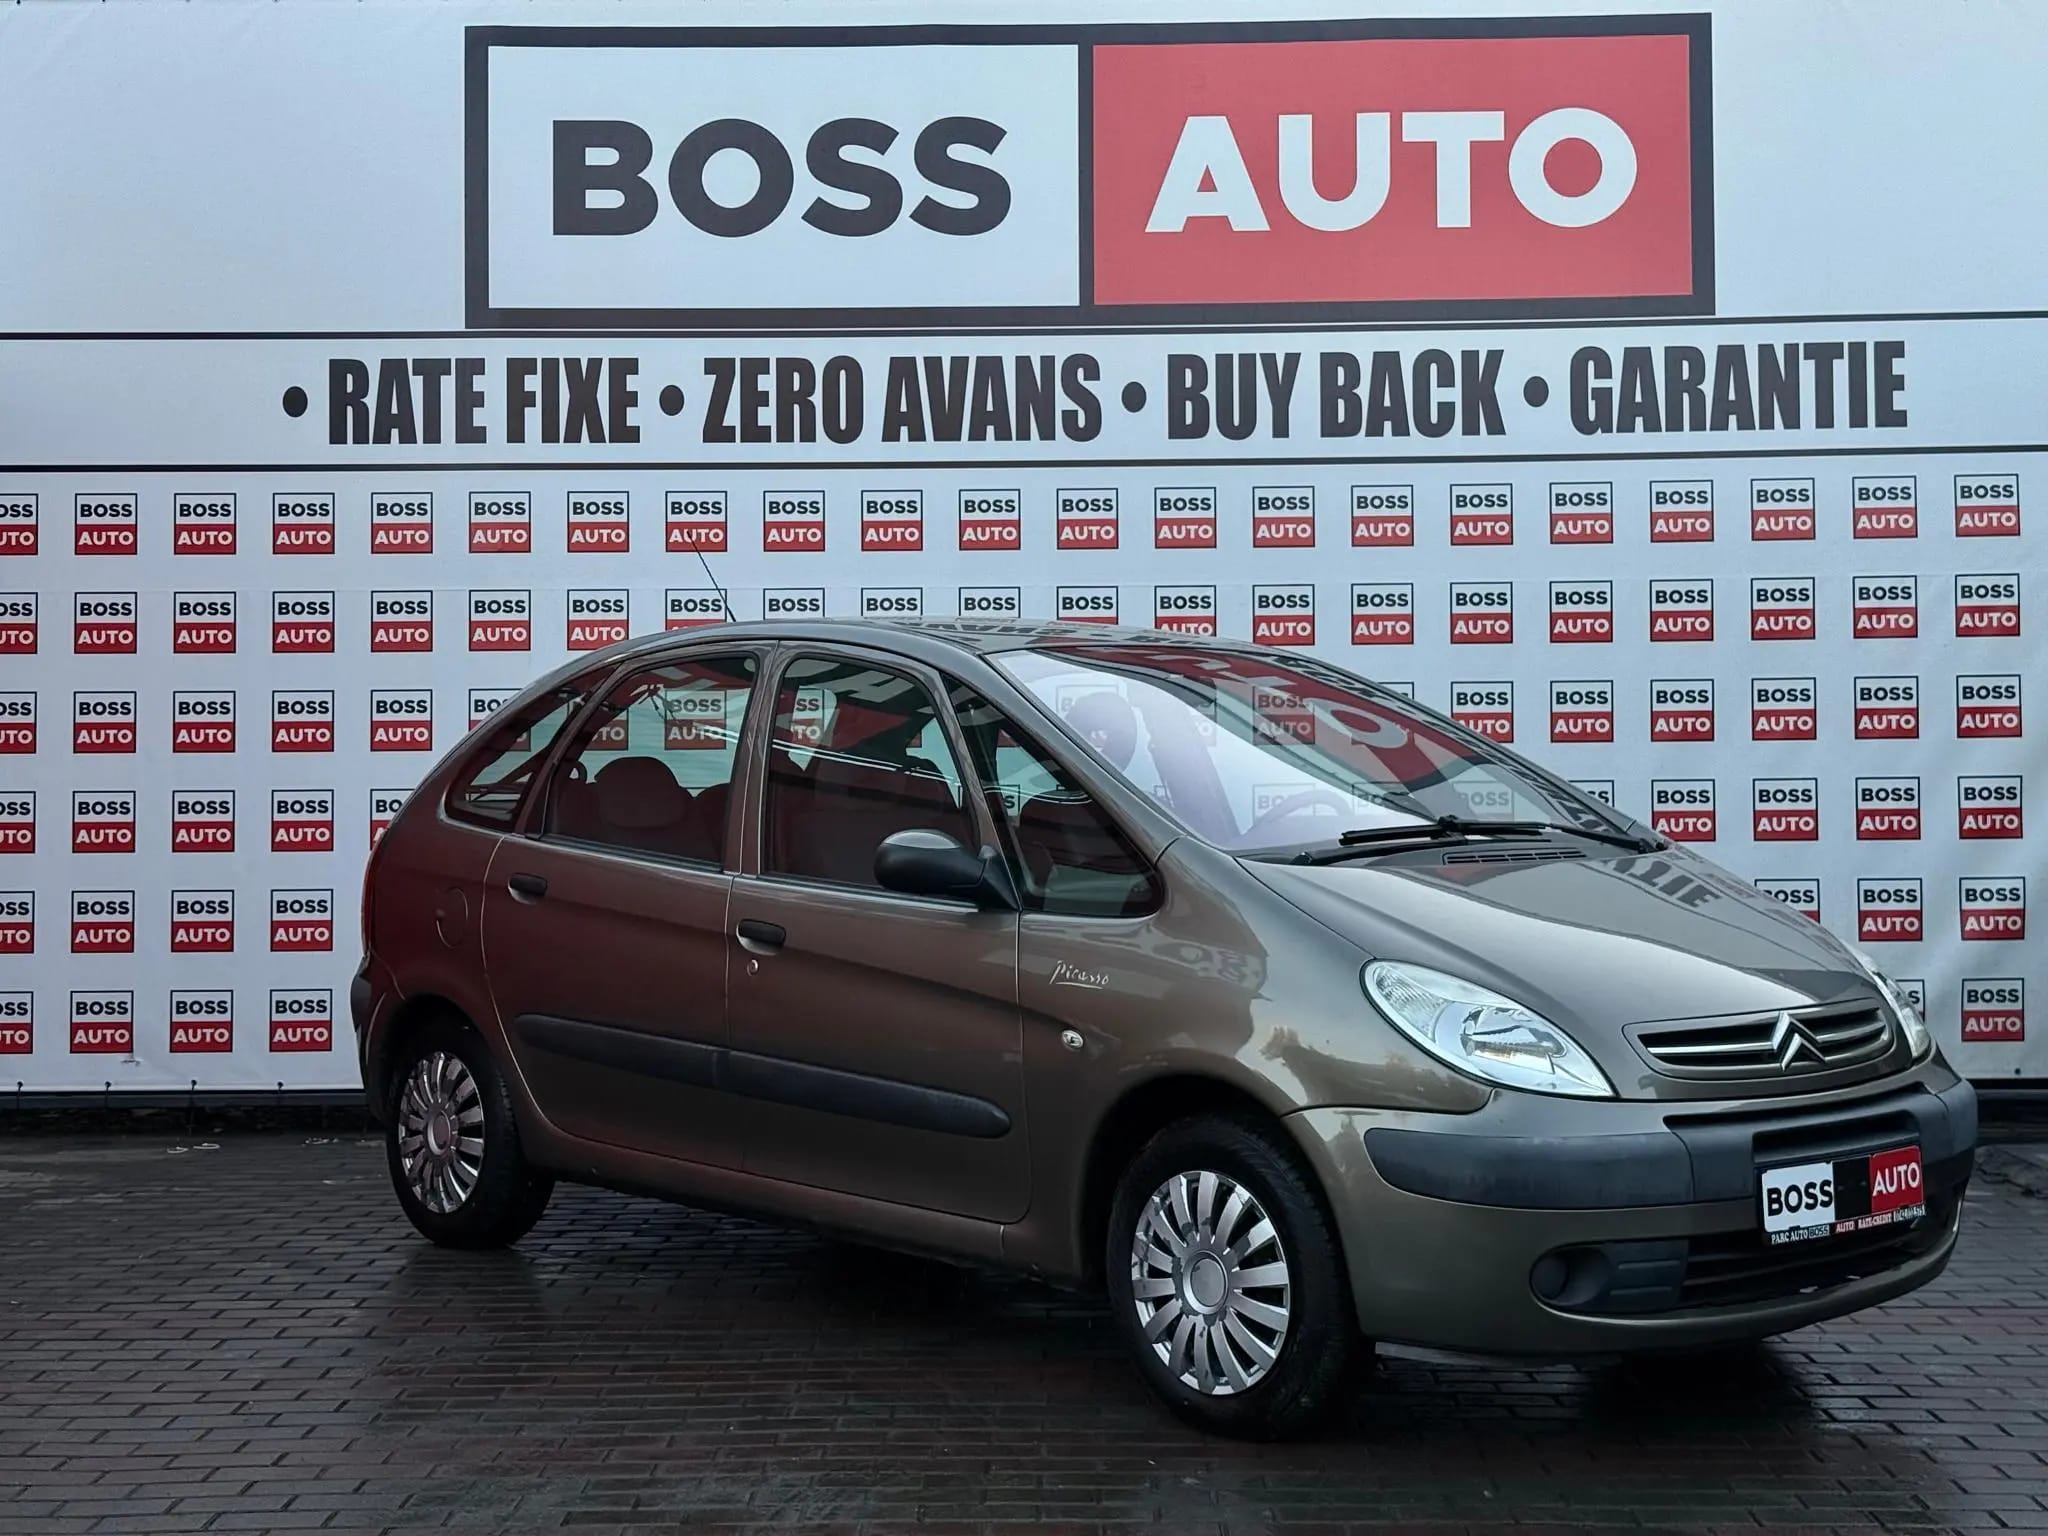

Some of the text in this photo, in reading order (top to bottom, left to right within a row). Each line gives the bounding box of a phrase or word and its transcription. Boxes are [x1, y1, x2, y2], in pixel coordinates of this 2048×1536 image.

[553, 107, 1637, 237] BOSS AUTO
[329, 341, 1907, 444] RATE FIXE ZERO AVANS BUY BACK GARANTIE
[1656, 491, 1708, 504] BOSS
[1757, 489, 1809, 502] BOSS
[1858, 487, 1911, 500] BOSS
[1960, 485, 2013, 498] BOSS
[1062, 499, 1113, 512] BOSS
[1160, 498, 1211, 511] BOSS
[1258, 497, 1309, 510] BOSS
[1357, 495, 1408, 509] BOSS
[1456, 494, 1507, 508] BOSS
[1555, 493, 1607, 506] BOSS
[81, 504, 132, 517] BOSS
[180, 504, 231, 517] BOSS
[279, 503, 329, 516] BOSS
[377, 503, 427, 516] BOSS
[475, 502, 526, 515] BOSS
[573, 502, 624, 515] BOSS
[671, 501, 722, 514] BOSS
[769, 501, 820, 514] BOSS
[867, 500, 917, 513] BOSS
[965, 500, 1015, 513] BOSS
[1655, 518, 1710, 532] AUTO
[1755, 516, 1811, 531] AUTO
[1857, 515, 1913, 529] AUTO
[1960, 512, 2016, 527] AUTO
[963, 527, 1017, 540] AUTO
[1061, 526, 1115, 539] AUTO
[1159, 525, 1213, 538] AUTO
[1257, 524, 1311, 537] AUTO
[1356, 523, 1410, 536] AUTO
[1455, 522, 1509, 536] AUTO
[1554, 520, 1609, 534] AUTO
[79, 532, 133, 545] AUTO
[178, 531, 232, 544] AUTO
[277, 531, 331, 544] AUTO
[375, 530, 429, 544] AUTO
[473, 530, 527, 543] AUTO
[572, 529, 625, 542] AUTO
[670, 529, 723, 542] AUTO
[767, 528, 821, 542] AUTO
[865, 528, 919, 541] AUTO
[1555, 591, 1607, 605] BOSS
[1656, 590, 1708, 603] BOSS
[1757, 588, 1809, 602] BOSS
[1859, 586, 1912, 600] BOSS
[1961, 585, 2014, 598] BOSS
[671, 599, 722, 612] BOSS
[769, 599, 819, 611] BOSS
[867, 598, 917, 611] BOSS
[965, 597, 1015, 610] BOSS
[1063, 597, 1113, 610] BOSS
[1160, 596, 1211, 609] BOSS
[1259, 595, 1309, 608] BOSS
[1357, 594, 1408, 607] BOSS
[1456, 592, 1507, 606] BOSS
[80, 603, 132, 616] BOSS
[180, 602, 231, 615] BOSS
[278, 602, 329, 615] BOSS
[377, 601, 427, 614] BOSS
[475, 600, 525, 613] BOSS
[573, 599, 624, 613] BOSS
[1554, 619, 1609, 633] AUTO
[1654, 618, 1709, 632] AUTO
[1755, 616, 1811, 630] AUTO
[1858, 614, 1913, 628] AUTO
[1960, 612, 2016, 627] AUTO
[1257, 623, 1311, 636] AUTO
[1356, 621, 1410, 635] AUTO
[1455, 620, 1509, 634] AUTO
[78, 630, 133, 644] AUTO
[178, 630, 232, 643] AUTO
[277, 629, 330, 643] AUTO
[375, 629, 429, 642] AUTO
[473, 628, 526, 641] AUTO
[571, 627, 625, 641] AUTO
[1457, 692, 1508, 705] BOSS
[1556, 691, 1608, 704] BOSS
[1656, 690, 1709, 703] BOSS
[1758, 688, 1811, 702] BOSS
[1860, 687, 1913, 700] BOSS
[1963, 686, 2015, 699] BOSS
[79, 702, 131, 715] BOSS
[179, 702, 230, 715] BOSS
[278, 701, 329, 714] BOSS
[376, 700, 427, 713] BOSS
[1554, 719, 1609, 733] AUTO
[1655, 718, 1710, 732] AUTO
[1756, 716, 1812, 731] AUTO
[1859, 715, 1915, 729] AUTO
[1961, 713, 2018, 728] AUTO
[77, 730, 132, 743] AUTO
[177, 729, 231, 743] AUTO
[276, 729, 330, 742] AUTO
[375, 728, 428, 741] AUTO
[1657, 790, 1710, 803] BOSS
[1759, 789, 1812, 802] BOSS
[1862, 788, 1915, 801] BOSS
[1964, 787, 2017, 800] BOSS
[78, 801, 130, 815] BOSS
[178, 801, 229, 814] BOSS
[277, 800, 328, 813] BOSS
[1656, 818, 1711, 832] AUTO
[1758, 817, 1814, 831] AUTO
[1861, 816, 1917, 830] AUTO
[1963, 815, 2018, 829] AUTO
[77, 829, 131, 843] AUTO
[176, 829, 231, 842] AUTO
[276, 828, 329, 841] AUTO
[1864, 889, 1917, 903] BOSS
[1965, 888, 2020, 902] BOSS
[77, 901, 129, 915] BOSS
[177, 901, 229, 914] BOSS
[277, 900, 328, 913] BOSS
[1863, 918, 1918, 931] AUTO
[1965, 916, 2021, 930] AUTO
[75, 929, 130, 943] AUTO
[175, 928, 230, 942] AUTO
[275, 928, 329, 941] AUTO
[1967, 989, 2019, 1003] BOSS
[4, 1003, 28, 1017] SS
[76, 1001, 128, 1015] BOSS
[176, 1001, 228, 1014] BOSS
[276, 1000, 327, 1013] BOSS
[1966, 1017, 2020, 1031] AUTO
[2, 1031, 29, 1045] TO
[74, 1030, 129, 1043] AUTO
[174, 1029, 229, 1042] AUTO
[274, 1028, 328, 1041] AUTO
[1767, 1162, 1920, 1216] BOSS AUTO
[1771, 1232, 1789, 1244] PARC
[1790, 1230, 1808, 1241] AUTO
